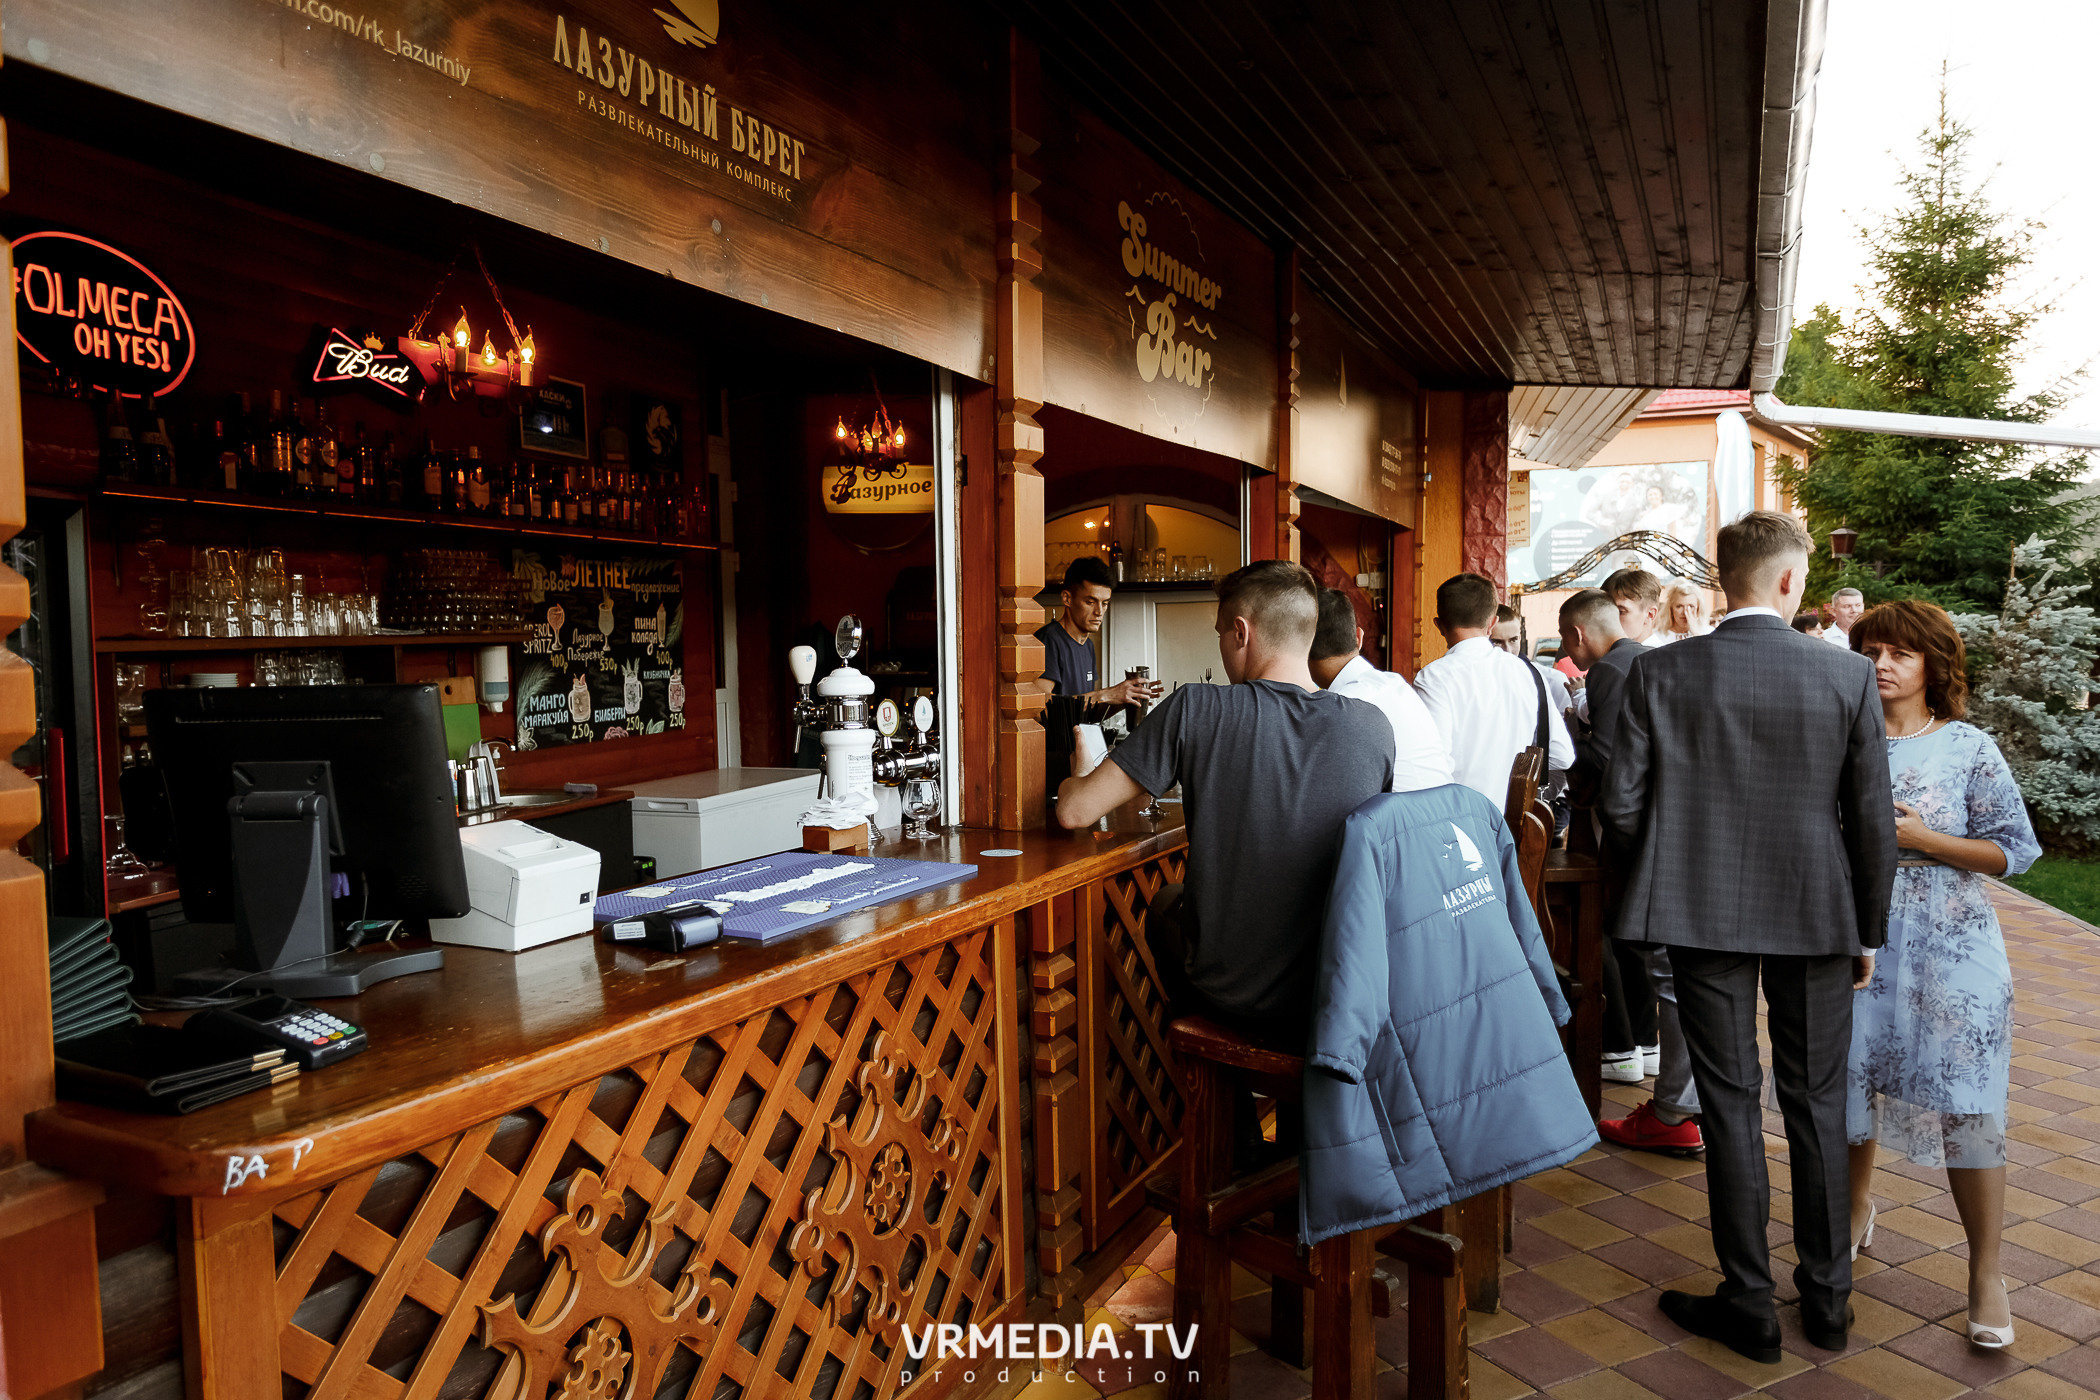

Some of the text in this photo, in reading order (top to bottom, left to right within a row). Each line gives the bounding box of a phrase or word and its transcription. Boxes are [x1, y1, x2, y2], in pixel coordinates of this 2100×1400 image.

[554, 15, 805, 180] ЛАЗУРНЫЙ БЕРЕГ
[578, 90, 792, 202] РАЗВЛЕКАТЕЛЬНЫЙ КОМПЛЕКС
[1118, 201, 1222, 311] Summer
[74, 323, 171, 373] OH YES!
[1137, 293, 1211, 388] Bar
[328, 343, 409, 383] Bud
[830, 472, 932, 504] Лазурное
[571, 559, 630, 589] ЛЕТНЕЕ
[631, 579, 680, 602] предложение
[572, 628, 603, 648] Лазурное
[635, 617, 656, 630] ПИНА
[523, 638, 552, 654] SPRITZ
[524, 710, 569, 728] МАРАКУЙЯ
[529, 693, 566, 712] МАНГО
